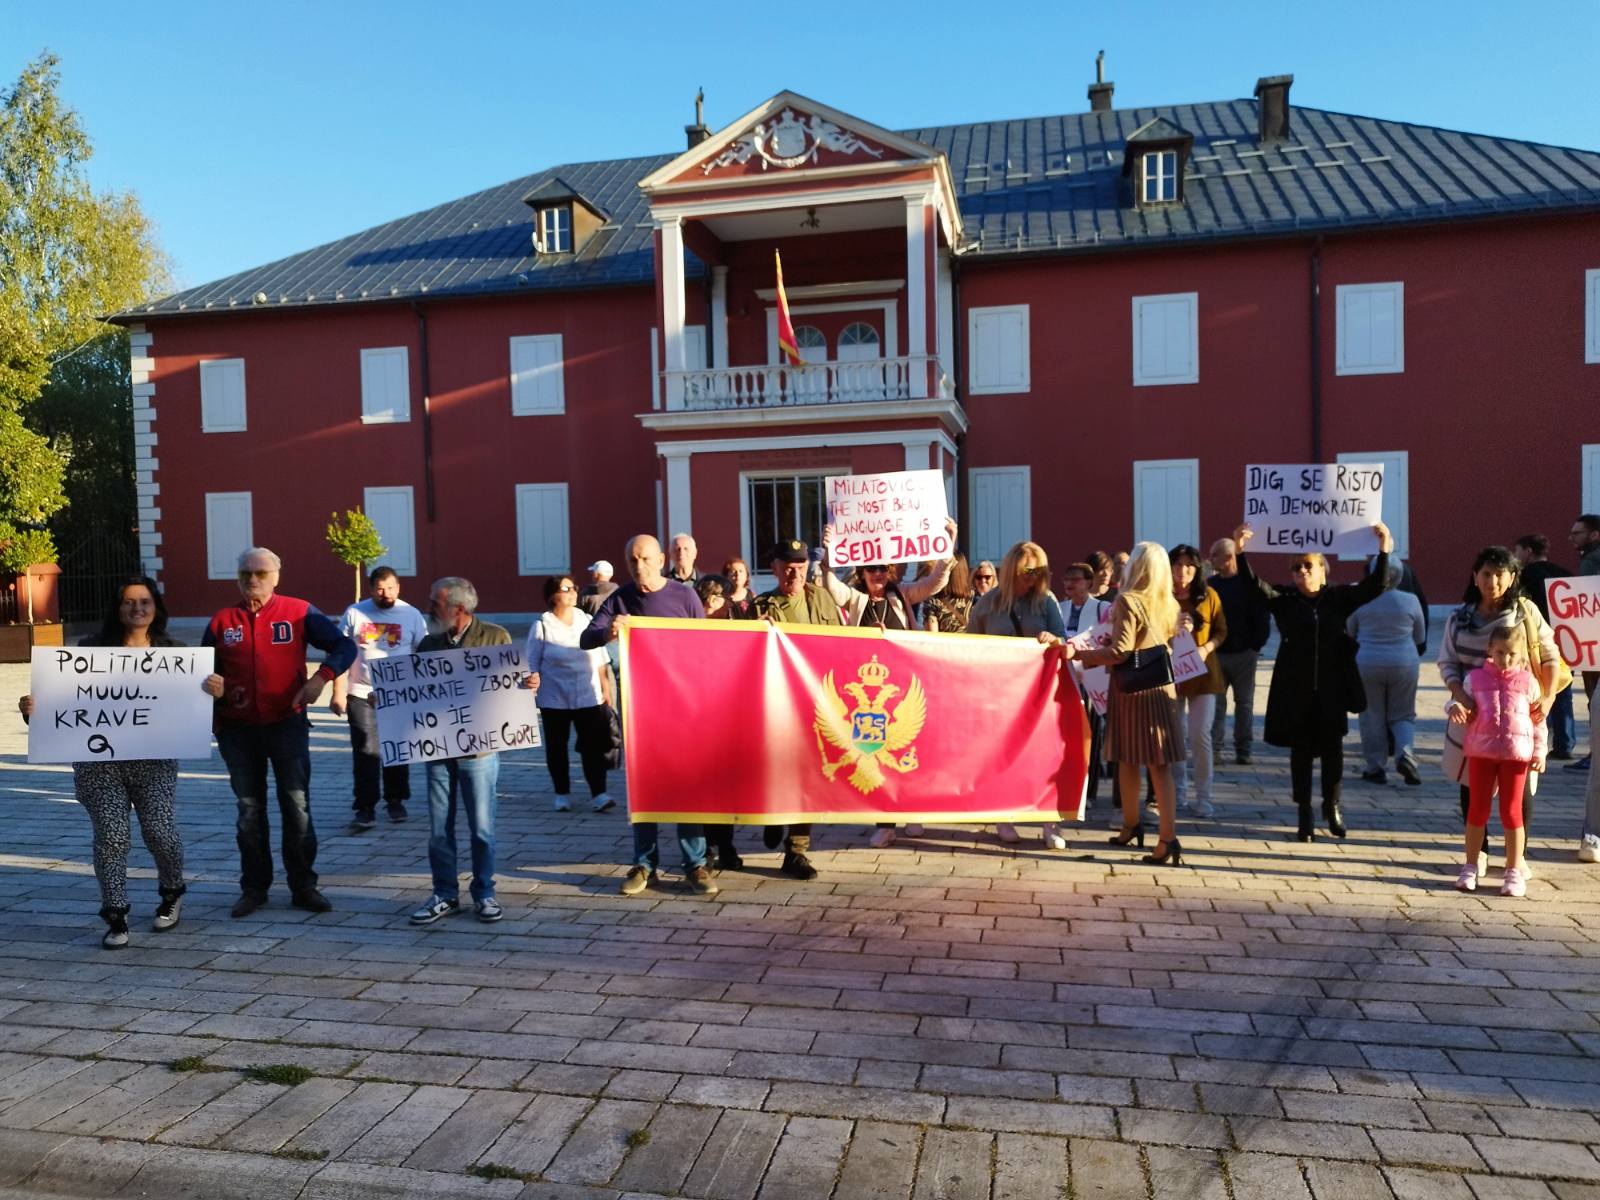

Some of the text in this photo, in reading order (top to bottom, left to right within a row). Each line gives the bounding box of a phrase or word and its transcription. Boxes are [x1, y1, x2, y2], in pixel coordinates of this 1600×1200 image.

[1300, 469, 1322, 491] SE
[829, 497, 920, 516] THE MOST BEAU
[1248, 496, 1367, 517] DA DEMOKRATE
[835, 518, 903, 535] LANGUAGE
[1267, 526, 1333, 549] LEGNU
[890, 535, 948, 559] JADO
[1548, 580, 1600, 619] GRA
[271, 620, 293, 644] D
[1554, 624, 1599, 667] OT
[464, 651, 490, 672] ŠTO
[499, 650, 520, 668] MU
[77, 685, 158, 700] MUUU...
[375, 680, 466, 710] DEMOKRATE
[55, 708, 152, 729] KRAVE
[414, 704, 472, 729] NO JE
[382, 722, 541, 765] DEMON CRNE GORE
